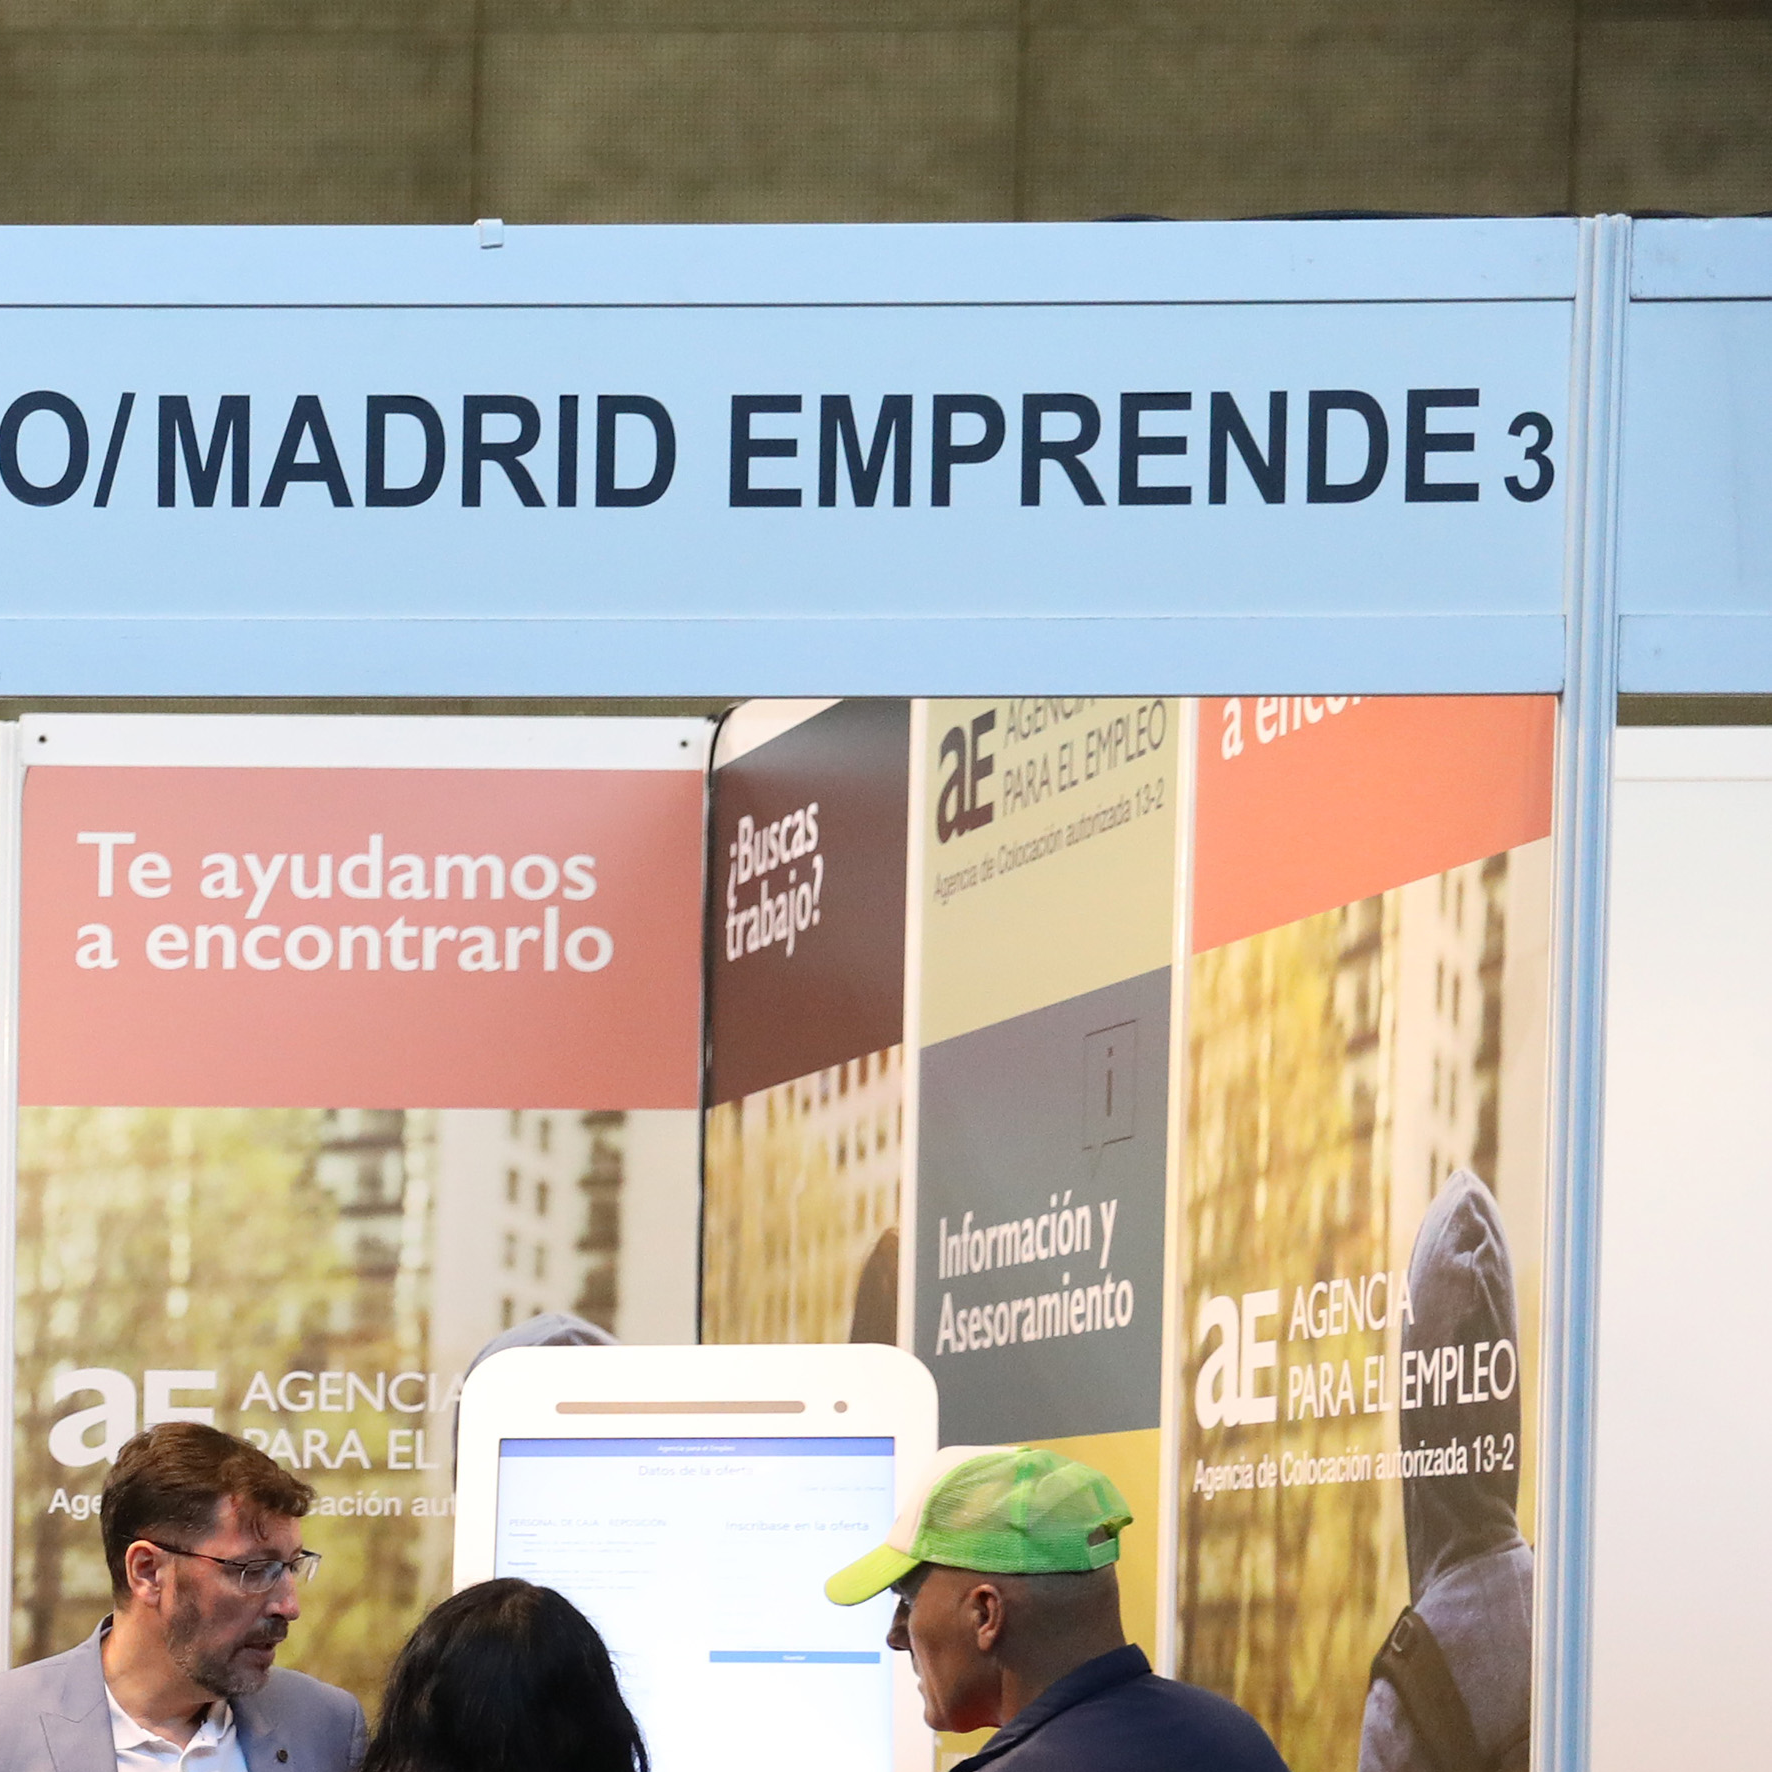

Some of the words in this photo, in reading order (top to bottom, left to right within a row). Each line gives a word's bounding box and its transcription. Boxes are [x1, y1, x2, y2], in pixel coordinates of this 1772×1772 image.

[727, 387, 1483, 511] EMPRENDE
[1503, 410, 1557, 505] 3
[936, 708, 997, 844] aE
[1002, 752, 1053, 817] PARA
[1058, 740, 1079, 792] EL
[1085, 700, 1167, 780] EMPLEO
[75, 830, 173, 899] Te
[199, 833, 598, 920] ayudamos
[726, 801, 820, 912] ¿Buscas
[934, 866, 978, 905] Agencia
[980, 853, 994, 884] de
[997, 824, 1063, 875] Colocación
[1065, 793, 1131, 847] autorizada
[1135, 776, 1164, 817] 13-2
[74, 922, 120, 970] a
[144, 905, 615, 973] encontrarlo
[724, 853, 825, 963] trabajo?
[938, 1189, 1092, 1280] Información
[1099, 1199, 1118, 1270] y
[935, 1271, 1134, 1356] Asesoramiento
[1288, 1269, 1415, 1343] AGENCIA
[1194, 1288, 1279, 1431] aE
[1287, 1359, 1357, 1421] PARA
[1363, 1354, 1394, 1415] EL
[1399, 1338, 1518, 1411] EMPLEO
[387, 1428, 440, 1471] EL
[638, 1465, 676, 1477] Datos
[679, 1465, 697, 1476] de
[700, 1465, 711, 1476] la
[1193, 1457, 1256, 1501] Agencia
[1257, 1453, 1277, 1489] de
[1280, 1444, 1372, 1488] Colocación
[1375, 1436, 1468, 1480] autorizada
[1472, 1431, 1516, 1474] 13-2
[794, 1521, 811, 1532] en
[814, 1520, 827, 1532] la
[830, 1520, 870, 1532] oferta
